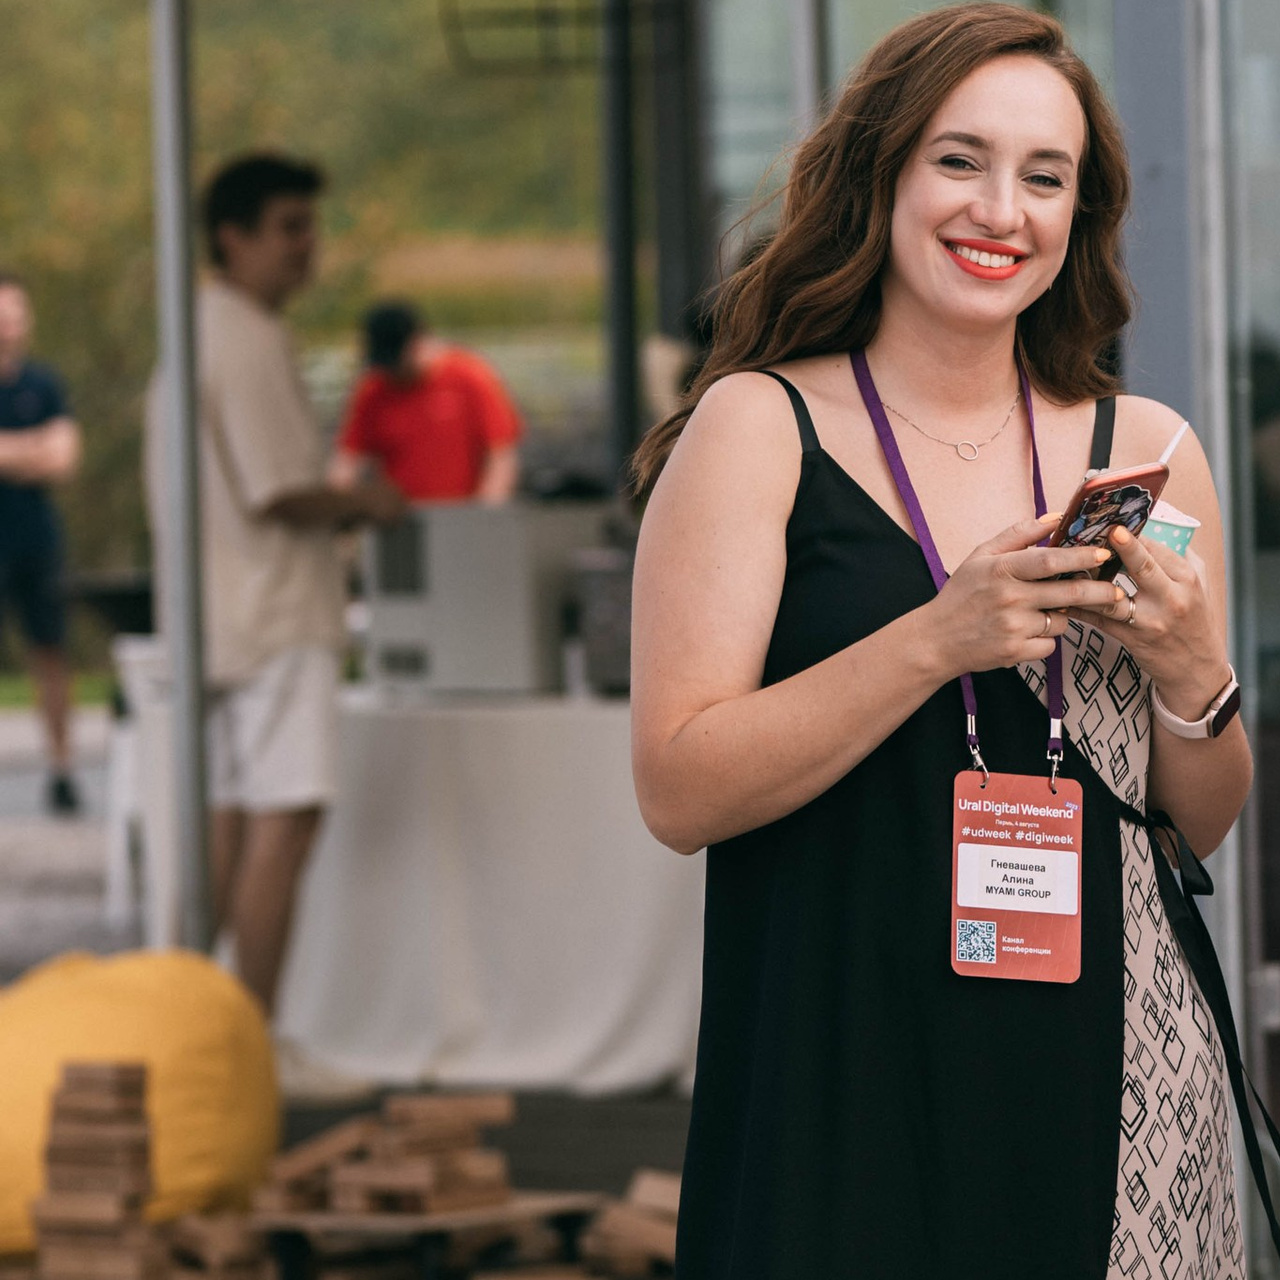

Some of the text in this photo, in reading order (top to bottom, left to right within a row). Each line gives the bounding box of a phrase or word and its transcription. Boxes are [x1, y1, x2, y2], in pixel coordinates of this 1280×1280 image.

[959, 799, 1073, 818] Ural Digital Weekend
[962, 826, 1073, 844] #udweek #digiweek
[991, 859, 1046, 872] Гневашева
[1002, 874, 1034, 885] Алина
[986, 886, 1051, 898] MYAMI GROUP
[1002, 936, 1024, 944] Канал
[1002, 946, 1051, 955] конференции
